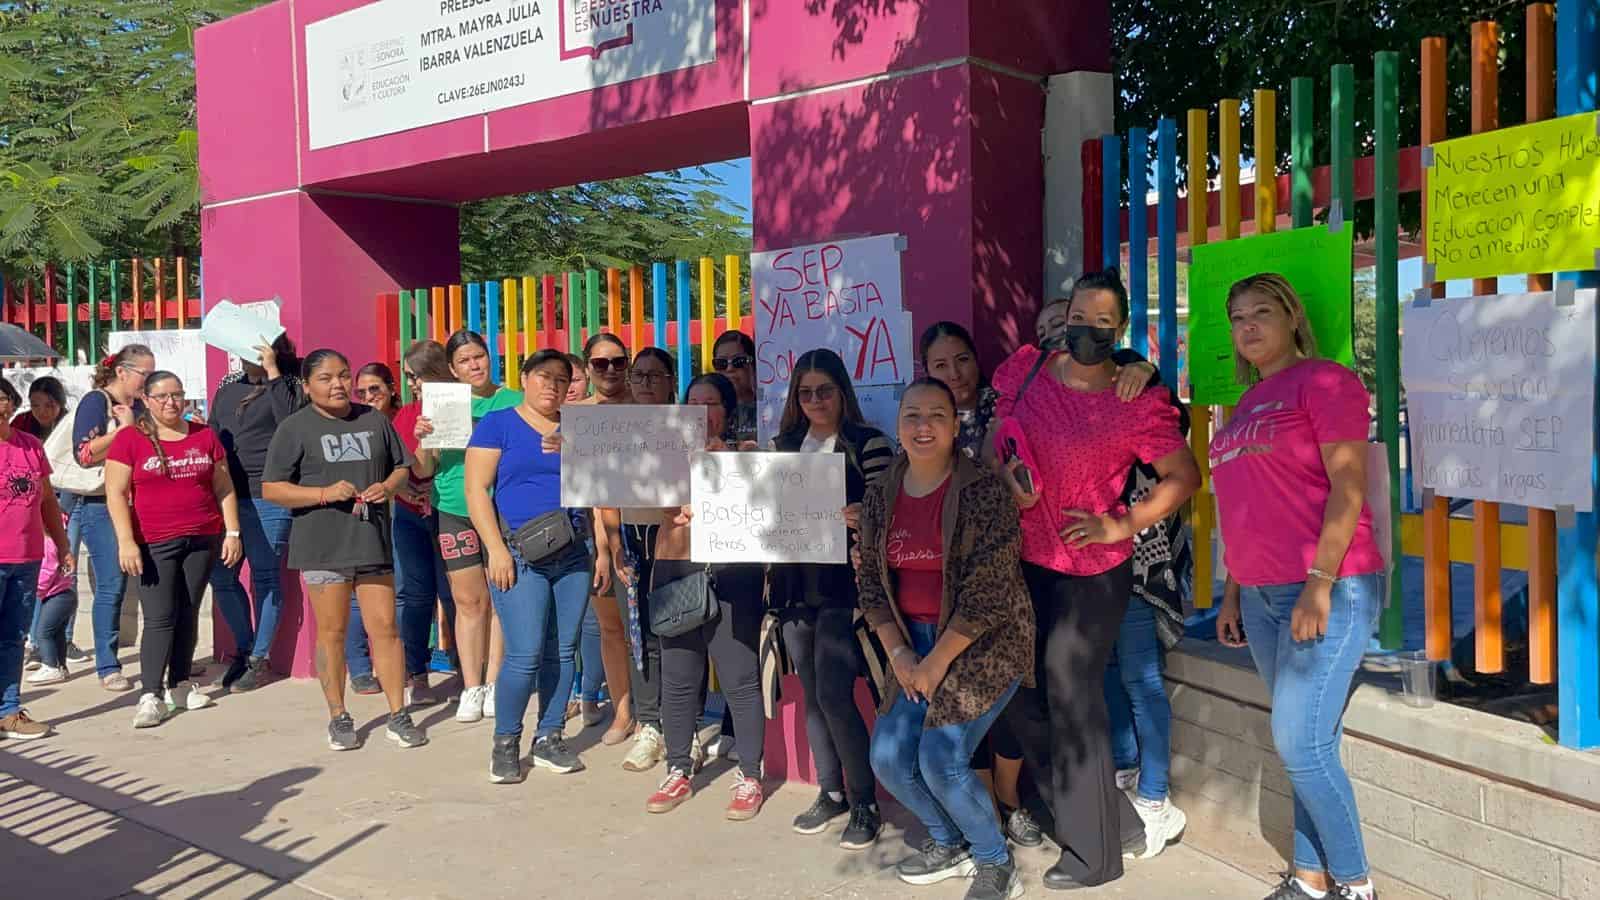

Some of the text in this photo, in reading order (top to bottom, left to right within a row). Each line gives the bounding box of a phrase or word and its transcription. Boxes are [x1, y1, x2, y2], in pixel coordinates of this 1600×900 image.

[420, 1, 541, 48] MTRA. MAYRA JULIA
[419, 26, 544, 72] IBARRA VALENZUELA
[1434, 140, 1544, 177] Nuestros
[1434, 170, 1565, 213] Merecen una
[772, 244, 843, 292] SEP
[1433, 244, 1462, 265] No
[1469, 245, 1482, 260] a
[760, 282, 884, 335] YA BASTA
[845, 316, 899, 380] YA
[321, 431, 372, 462] CAT
[1519, 416, 1562, 449] SEP
[702, 501, 766, 527] Basta
[775, 503, 795, 524] de
[439, 529, 481, 560] 23
